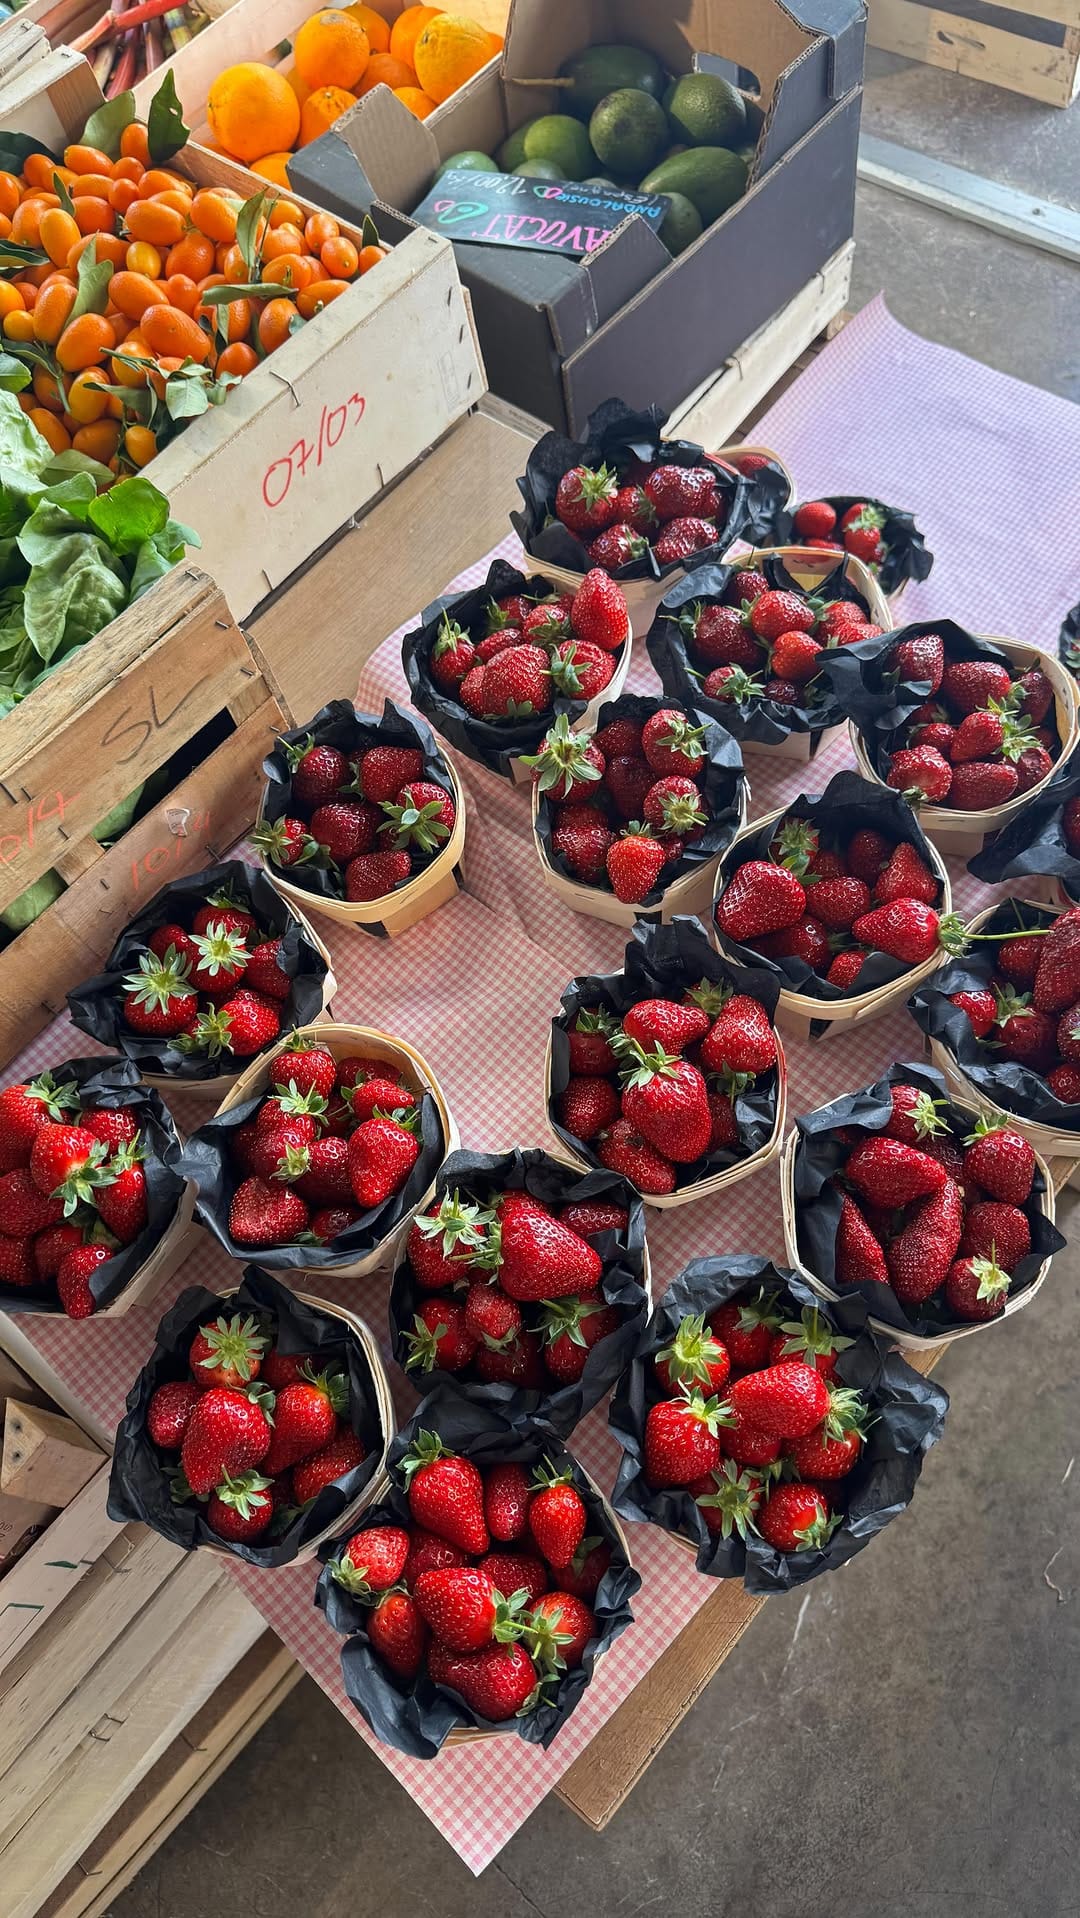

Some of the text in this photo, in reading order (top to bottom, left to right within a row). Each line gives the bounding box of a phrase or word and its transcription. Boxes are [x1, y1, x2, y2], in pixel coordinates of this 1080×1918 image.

[556, 193, 661, 218] ANDALOUSIE
[471, 214, 612, 253] AVOCAT
[262, 392, 366, 508] 07/03
